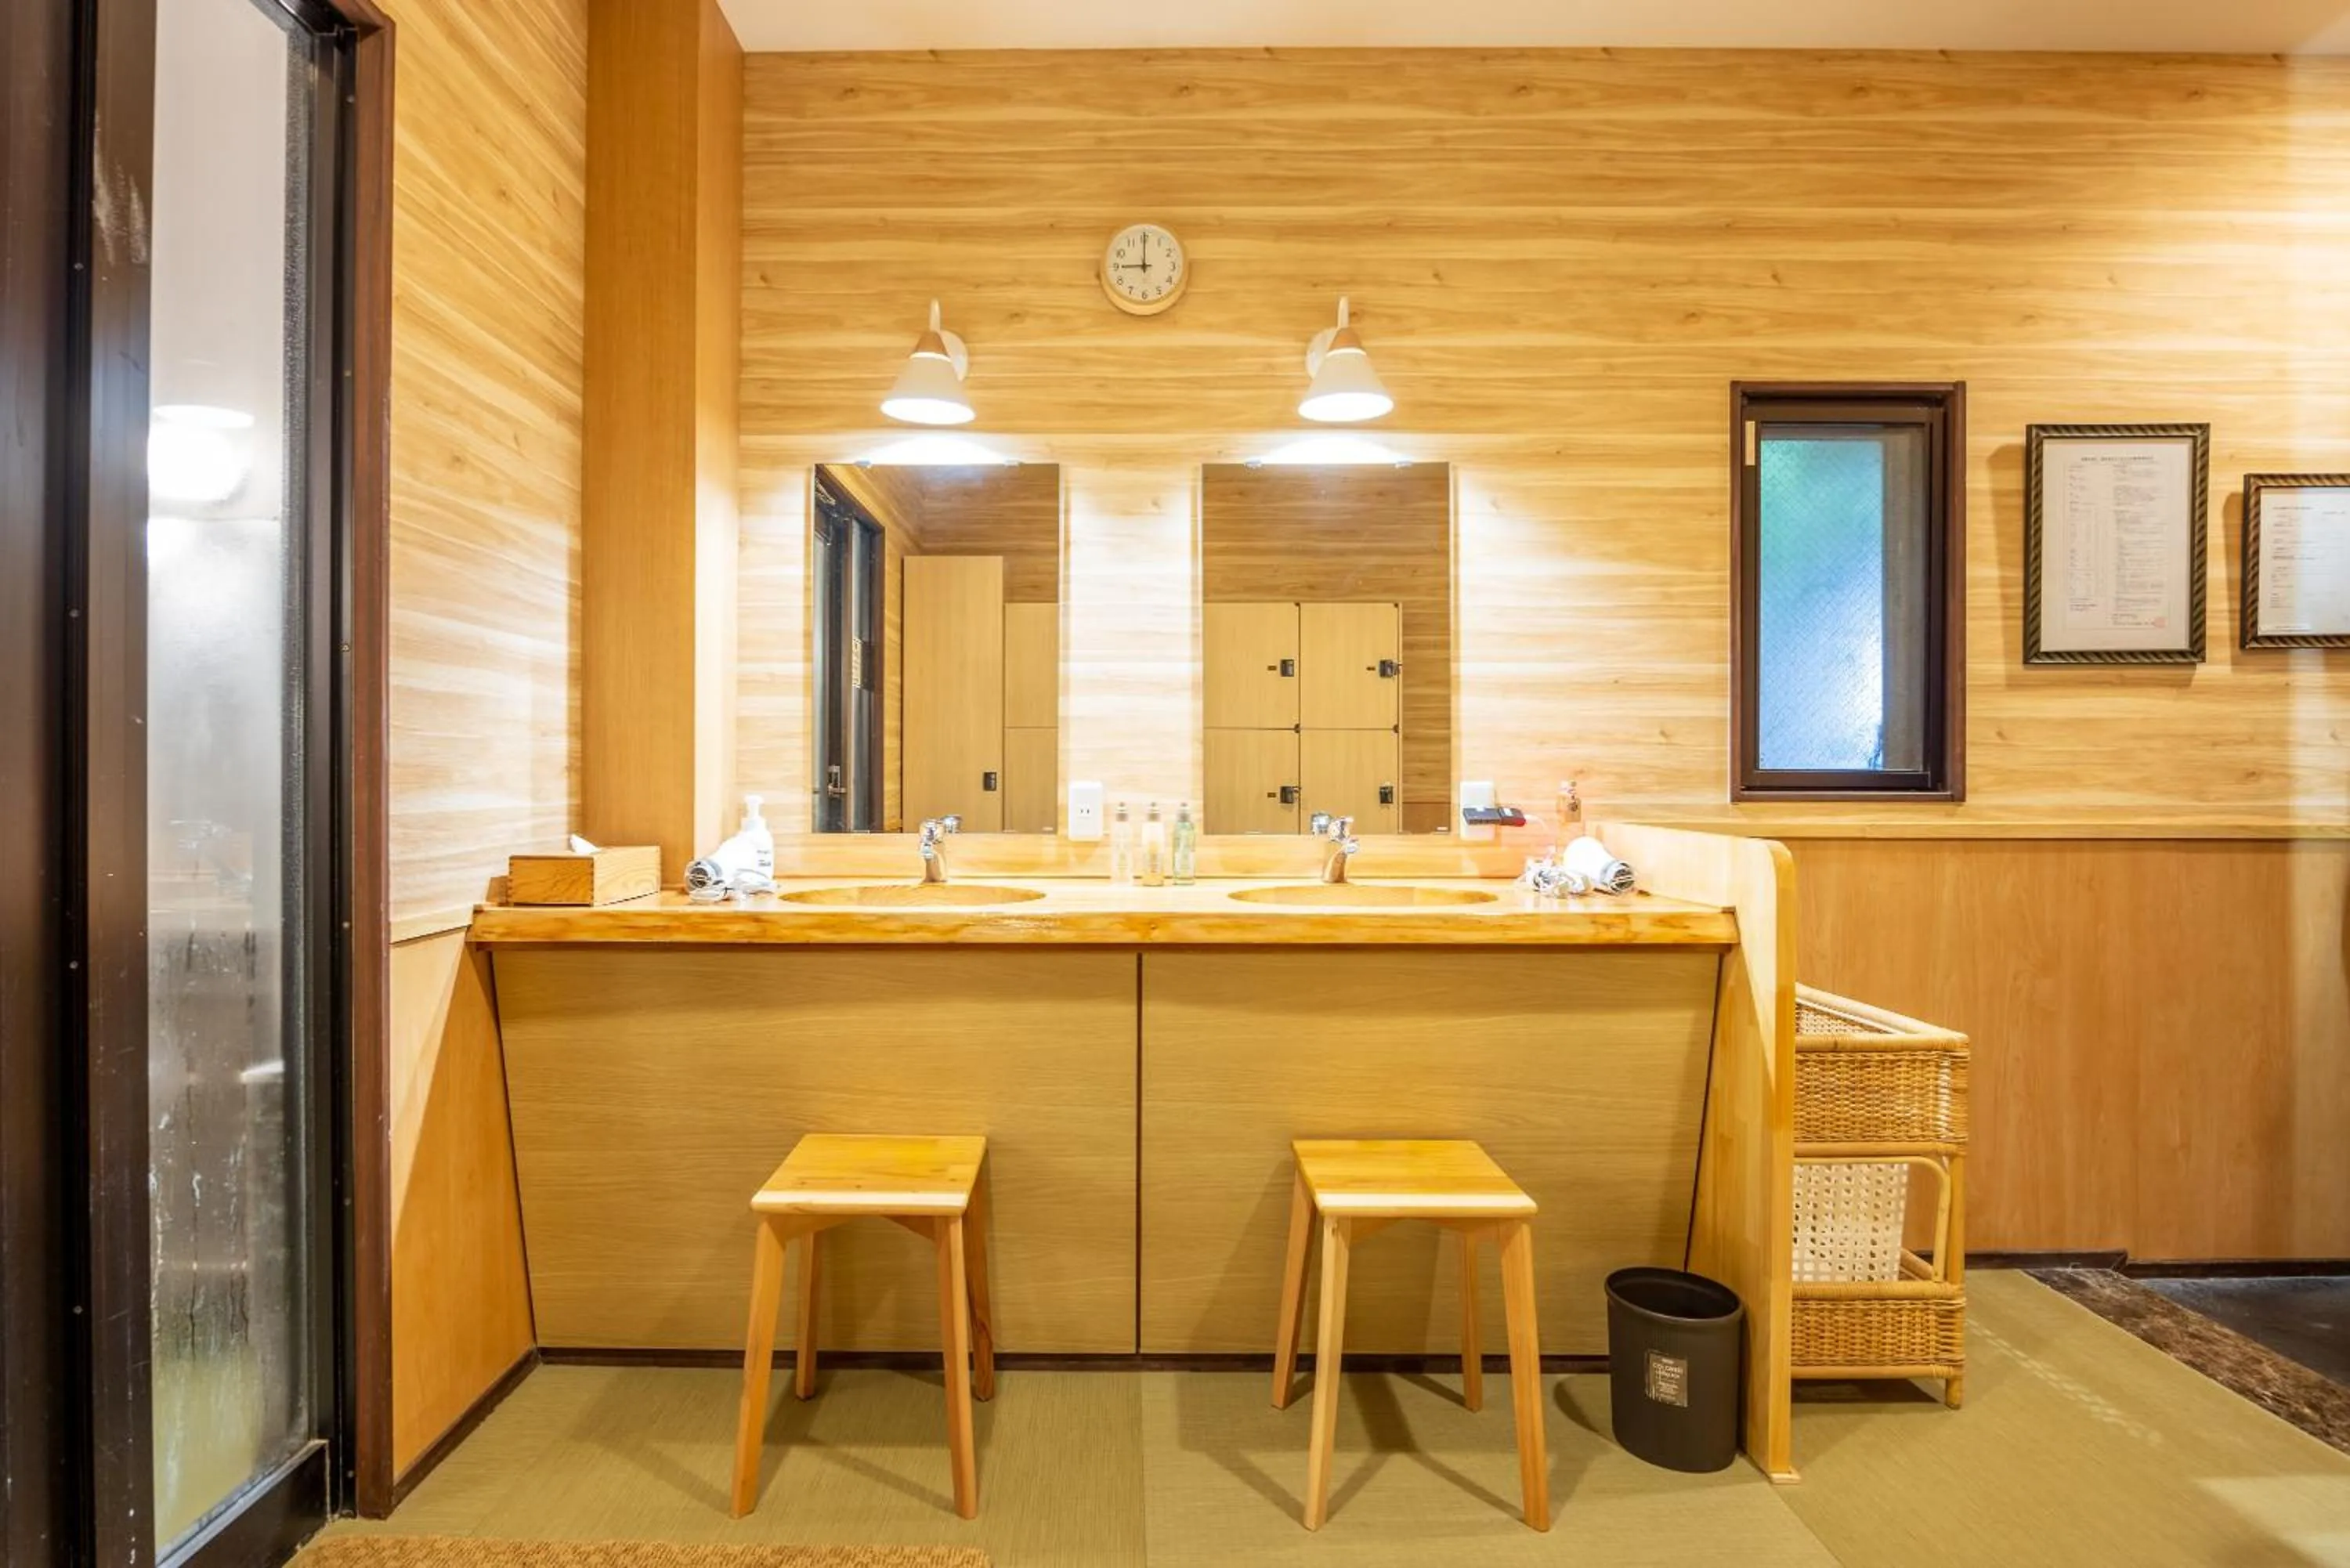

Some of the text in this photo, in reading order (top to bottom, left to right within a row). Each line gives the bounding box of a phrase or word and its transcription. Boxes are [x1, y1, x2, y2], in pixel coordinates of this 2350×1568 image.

[1116, 249, 1126, 258] 10
[1166, 248, 1173, 258] 2
[1170, 262, 1176, 272] 3
[1116, 276, 1124, 285] 8
[1166, 276, 1173, 285] 4
[1128, 287, 1133, 295] 7
